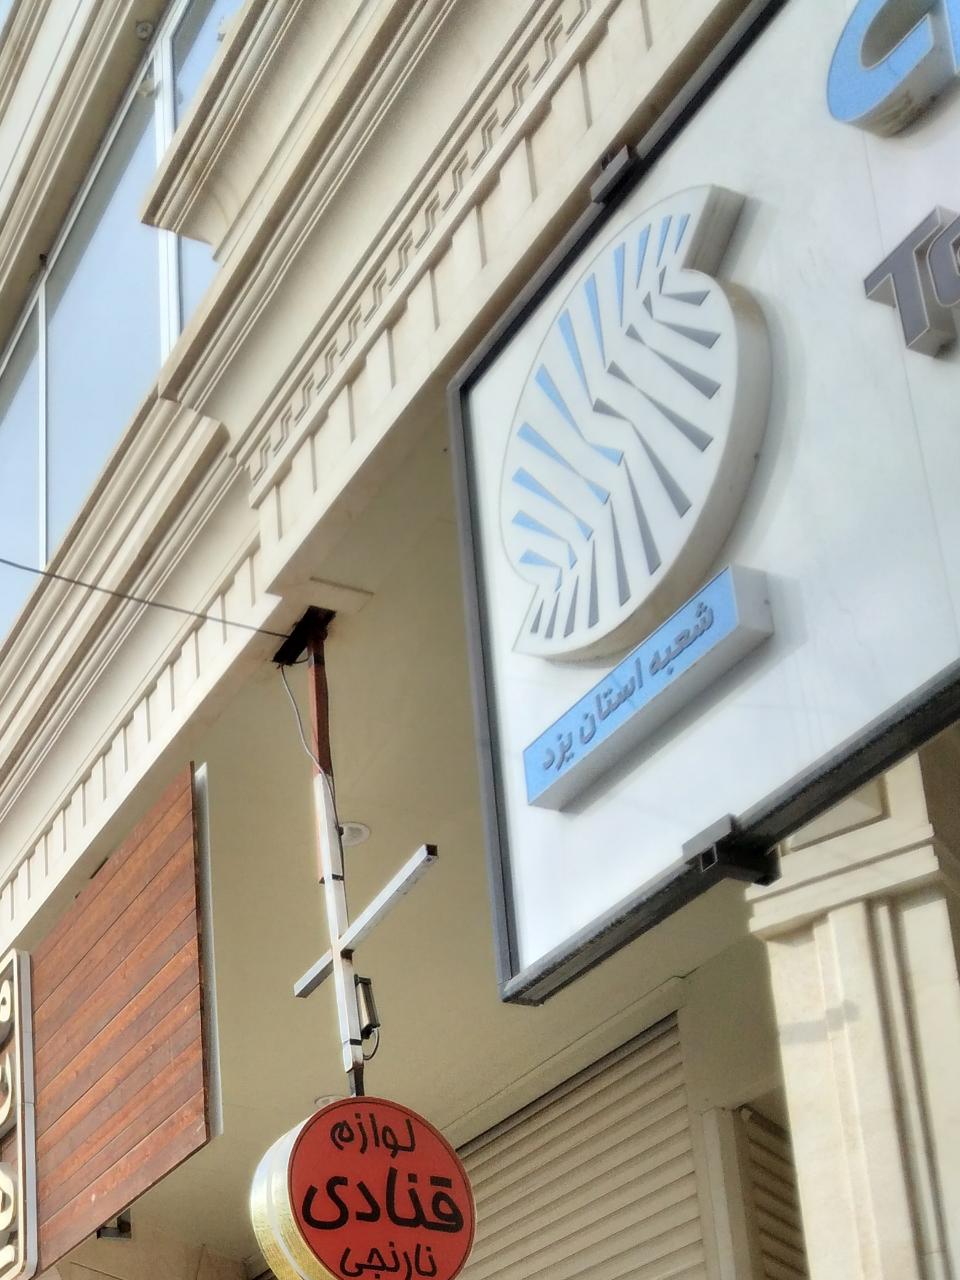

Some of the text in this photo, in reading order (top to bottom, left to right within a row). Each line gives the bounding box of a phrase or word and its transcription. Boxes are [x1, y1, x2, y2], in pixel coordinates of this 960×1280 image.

[542, 601, 715, 772] شعبه استان یزد
[330, 1112, 417, 1159] لوازم
[301, 1166, 465, 1234] قنادی
